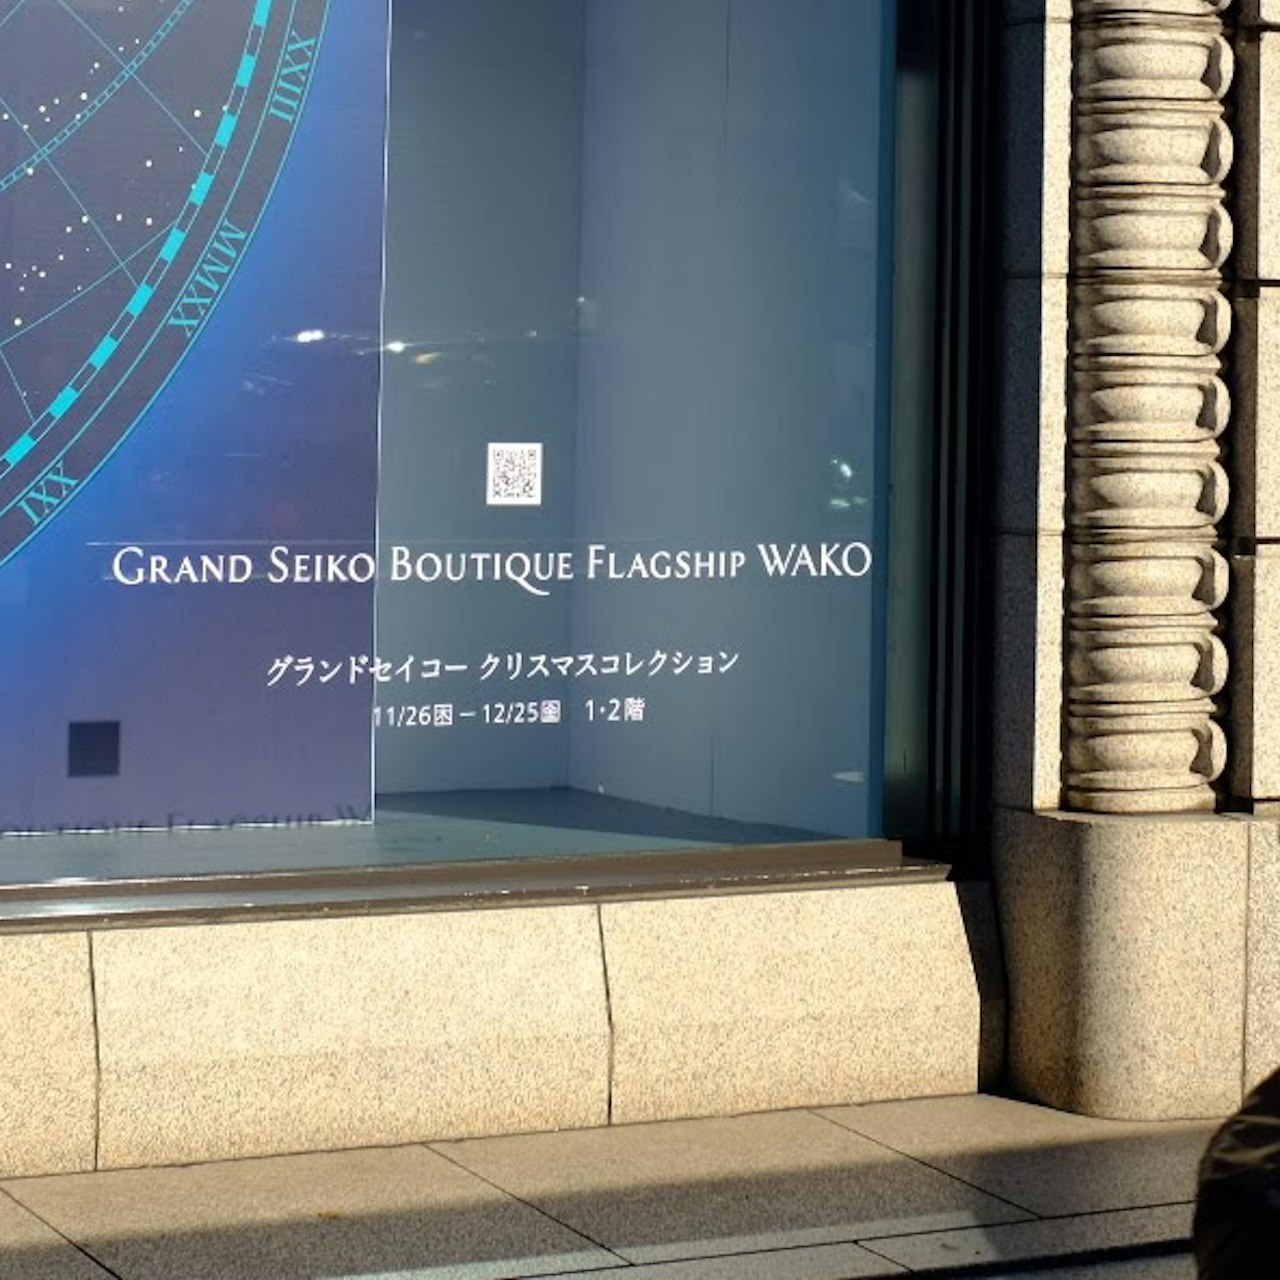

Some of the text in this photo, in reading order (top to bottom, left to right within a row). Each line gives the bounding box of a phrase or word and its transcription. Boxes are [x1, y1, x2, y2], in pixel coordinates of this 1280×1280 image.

[267, 29, 318, 123] XXIII
[165, 218, 248, 338] MMXX
[19, 459, 79, 526] XXI
[756, 541, 873, 577] WAKO
[267, 650, 739, 687] グランドセイコー クリスマスコレクション
